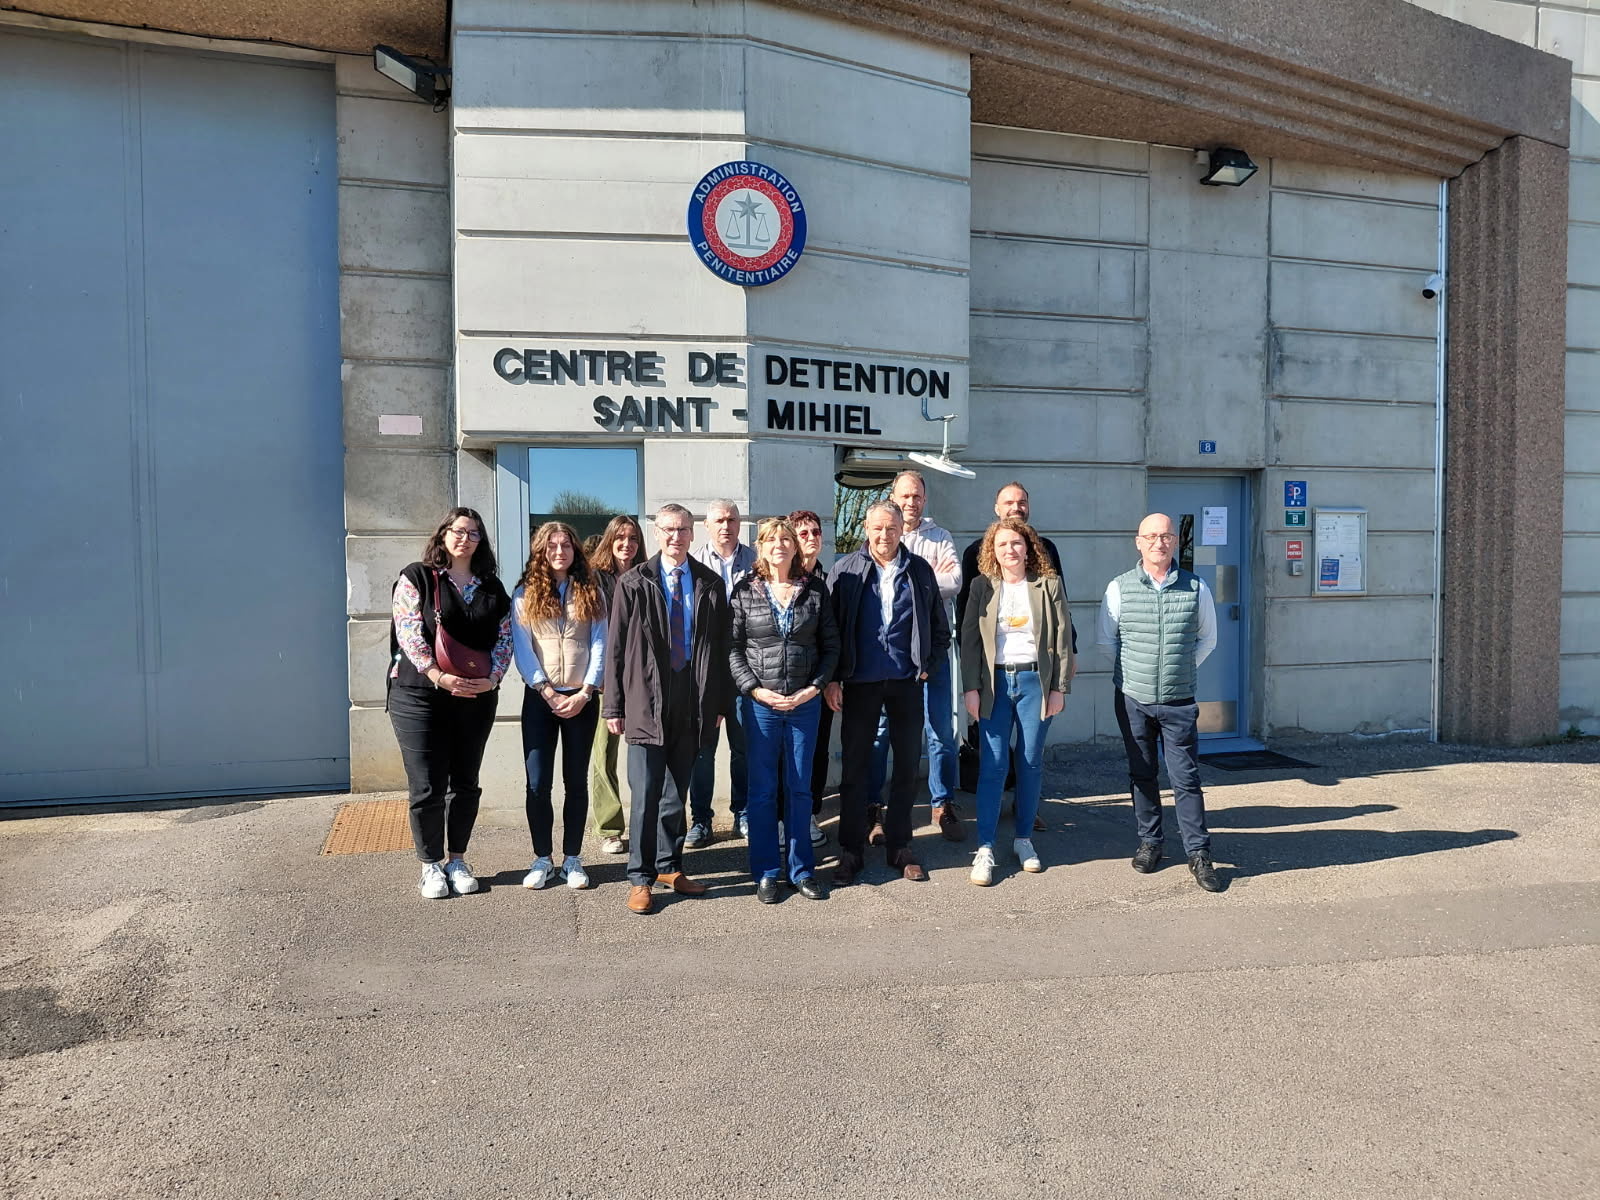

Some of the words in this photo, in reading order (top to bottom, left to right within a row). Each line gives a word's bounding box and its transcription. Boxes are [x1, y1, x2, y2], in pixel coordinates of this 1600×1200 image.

[695, 163, 802, 213] ADMINISTRATION
[697, 241, 798, 283] PENITENTIAIRE
[493, 347, 658, 382] CENTRE
[688, 351, 738, 384] DE
[765, 354, 950, 399] DETENTION
[593, 395, 712, 427] SAINT
[767, 398, 882, 435] MIHIEL
[1205, 442, 1211, 452] 8
